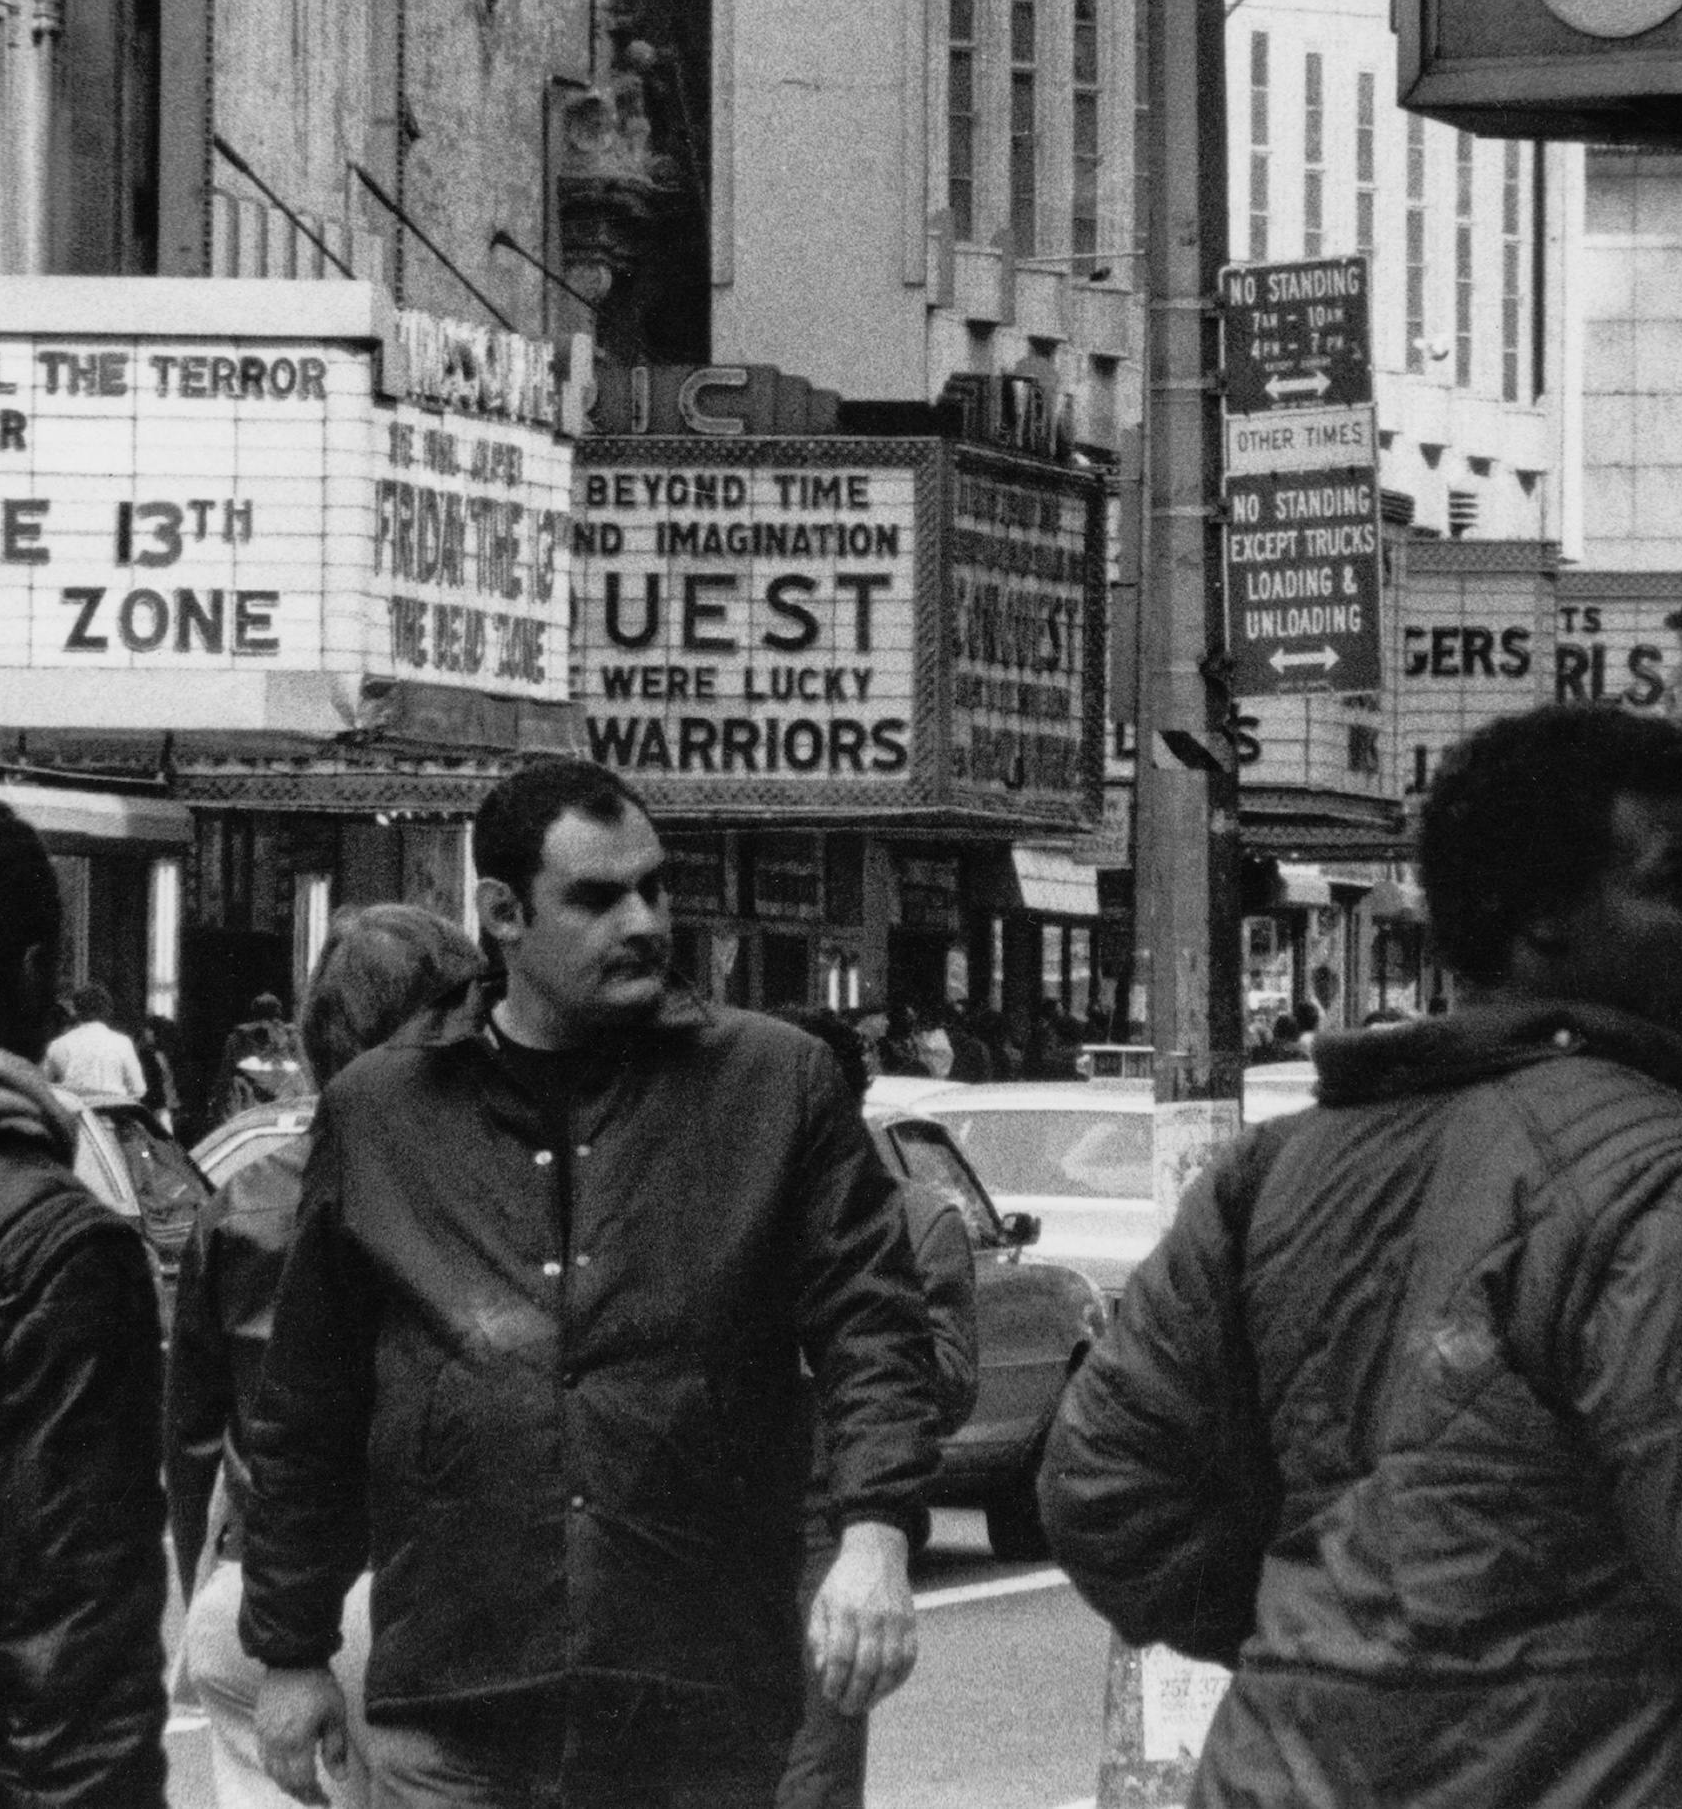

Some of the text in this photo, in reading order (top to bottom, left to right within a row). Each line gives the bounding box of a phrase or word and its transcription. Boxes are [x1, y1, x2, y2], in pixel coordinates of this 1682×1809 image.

[1230, 266, 1359, 306] NO STANDING
[37, 350, 129, 396] THE
[149, 353, 327, 401] TERROR
[1237, 422, 1363, 452] OTHER TIMES
[585, 474, 870, 511] BEYOND TIME
[1233, 485, 1371, 523] NO STANDING
[116, 499, 253, 569] 13TH
[656, 522, 899, 558] IMAGINATION
[1230, 523, 1375, 562] EXCEPT TRUCKS
[1247, 566, 1357, 601] LOADING &
[61, 586, 280, 657] ZONE
[603, 572, 892, 653] UEST
[1246, 604, 1361, 639] UNLOADING
[1561, 608, 1602, 633] TS
[602, 667, 874, 704] WERE LUCKY
[587, 716, 909, 774] WARRIORS
